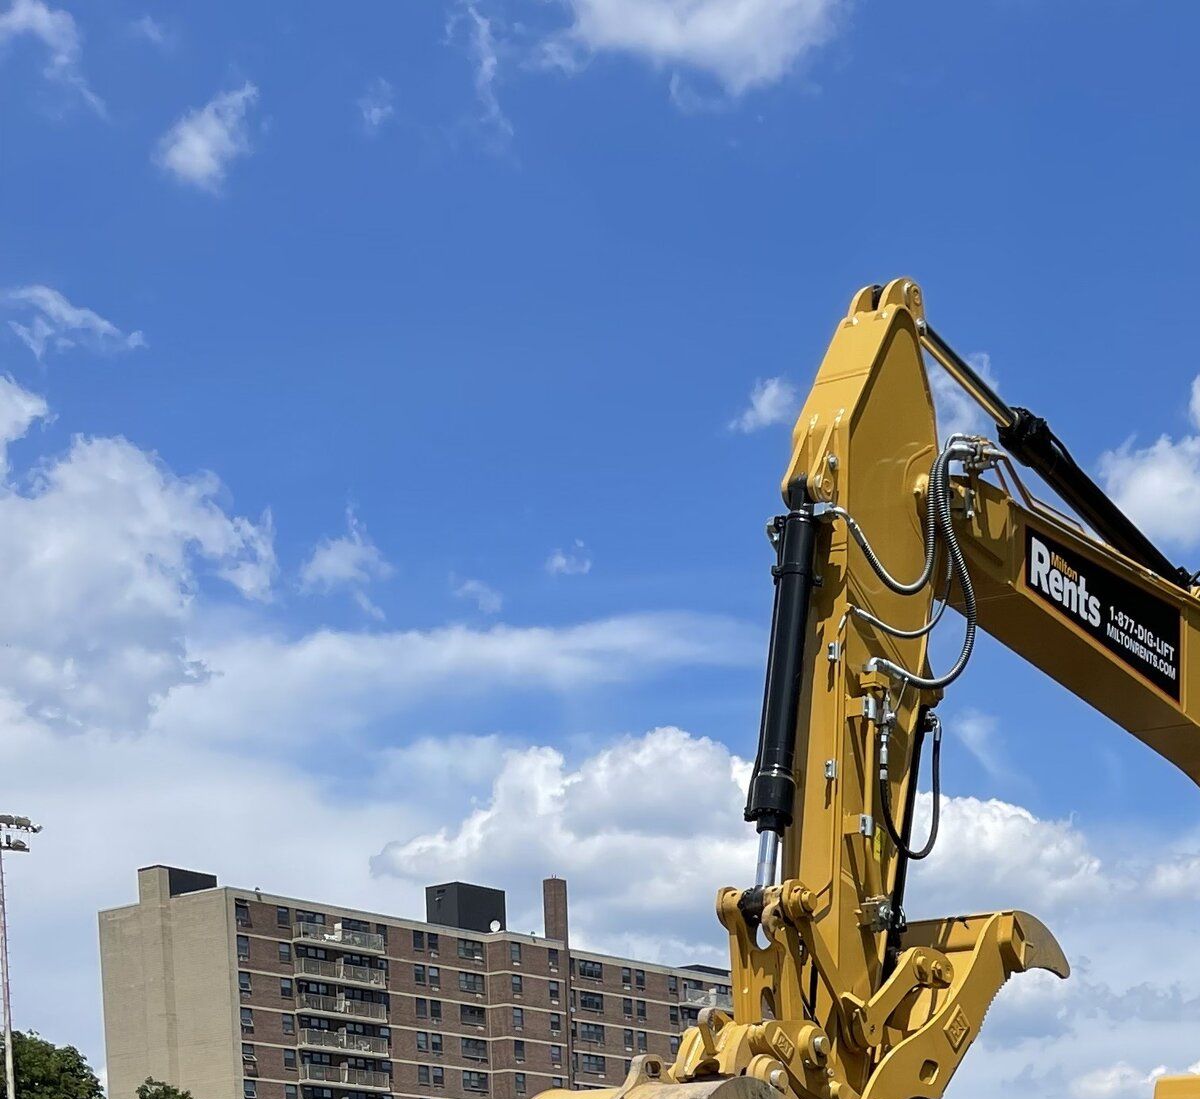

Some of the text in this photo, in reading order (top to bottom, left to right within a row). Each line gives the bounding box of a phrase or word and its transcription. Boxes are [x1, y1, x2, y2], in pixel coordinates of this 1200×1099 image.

[1030, 536, 1101, 628] Rents
[1050, 552, 1078, 582] Milton
[1106, 622, 1176, 680] MILTONRENTS.COM
[1109, 605, 1175, 661] 1-877-DIG-LIFT
